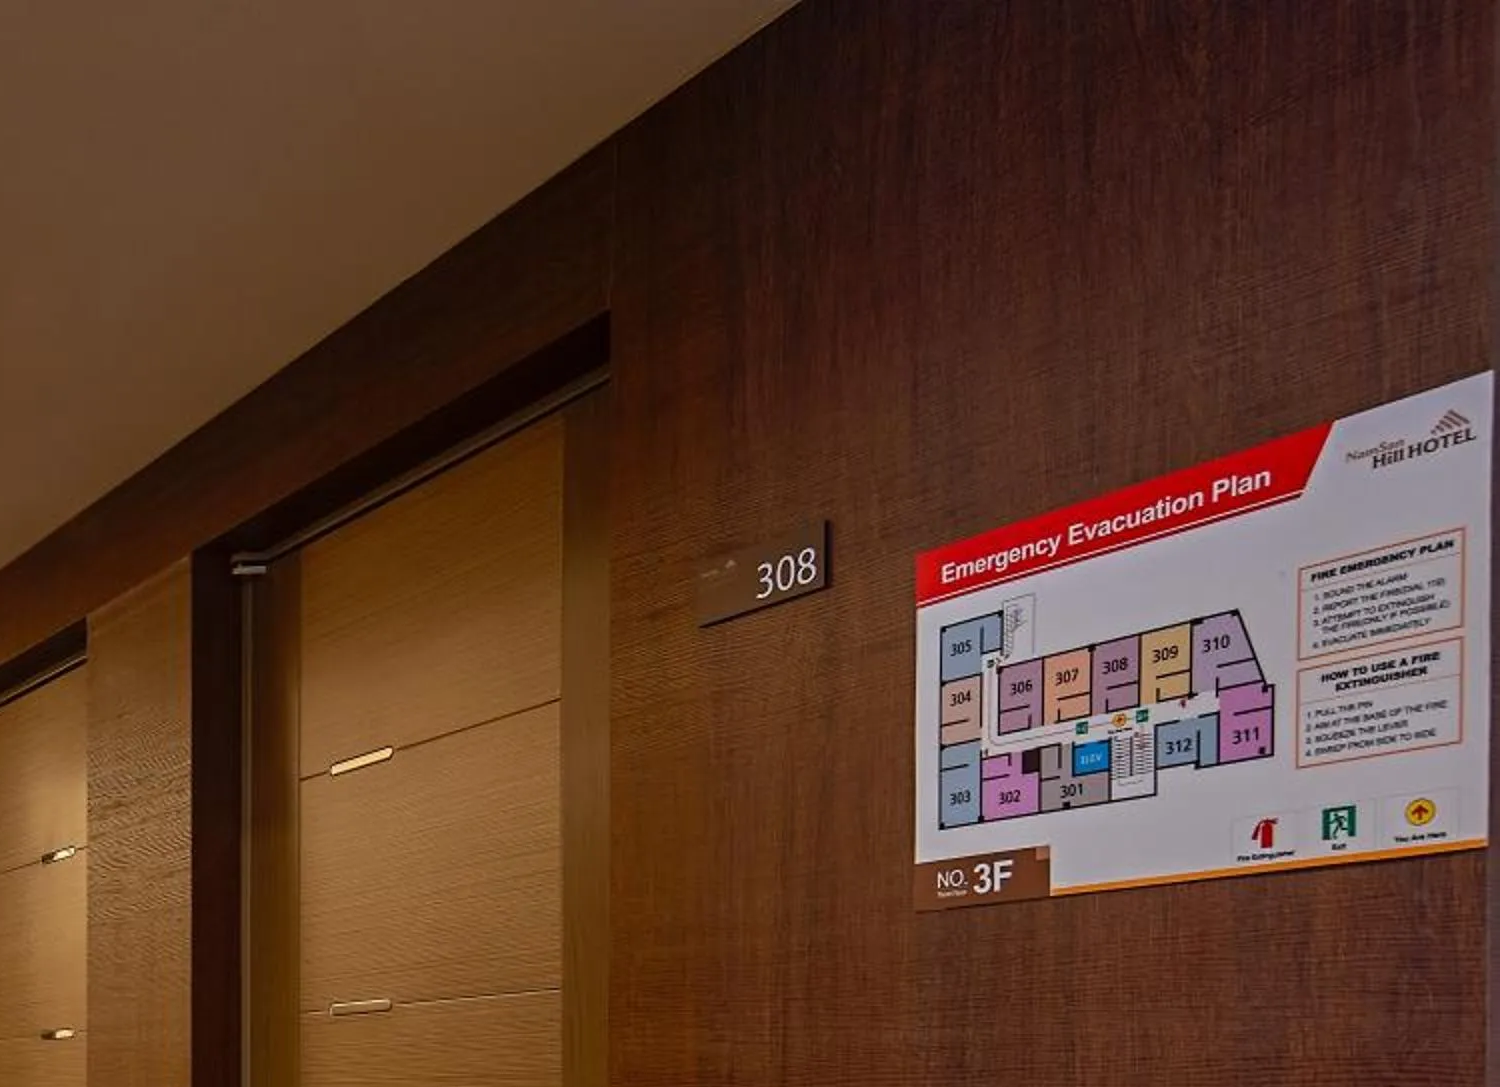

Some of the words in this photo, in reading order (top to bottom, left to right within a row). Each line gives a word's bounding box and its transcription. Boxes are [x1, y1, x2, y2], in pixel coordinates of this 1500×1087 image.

[1372, 448, 1405, 469] Hill
[1407, 428, 1476, 459] HOTEL
[941, 534, 1062, 584] Emergency
[1067, 490, 1204, 546] Evacuation
[1211, 470, 1271, 503] Plan
[1311, 568, 1337, 582] FIRE
[1419, 539, 1455, 555] PLAN
[756, 547, 817, 599] 308
[950, 640, 972, 656] 305
[1203, 635, 1231, 652] 310
[1152, 645, 1179, 663] 309
[1102, 657, 1129, 674] 308
[1321, 668, 1349, 683] HOW
[1352, 665, 1368, 677] TO
[1371, 659, 1397, 673] USE
[1400, 656, 1409, 667] A
[1411, 651, 1441, 665] FIRE
[1055, 669, 1079, 685] 307
[1010, 680, 1033, 696] 306
[950, 690, 971, 706] 304
[1232, 727, 1259, 745] 311
[1166, 738, 1191, 755] 312
[950, 791, 971, 805] 303
[999, 790, 1021, 805] 302
[1060, 783, 1083, 798] 301
[973, 860, 1014, 894] 3F
